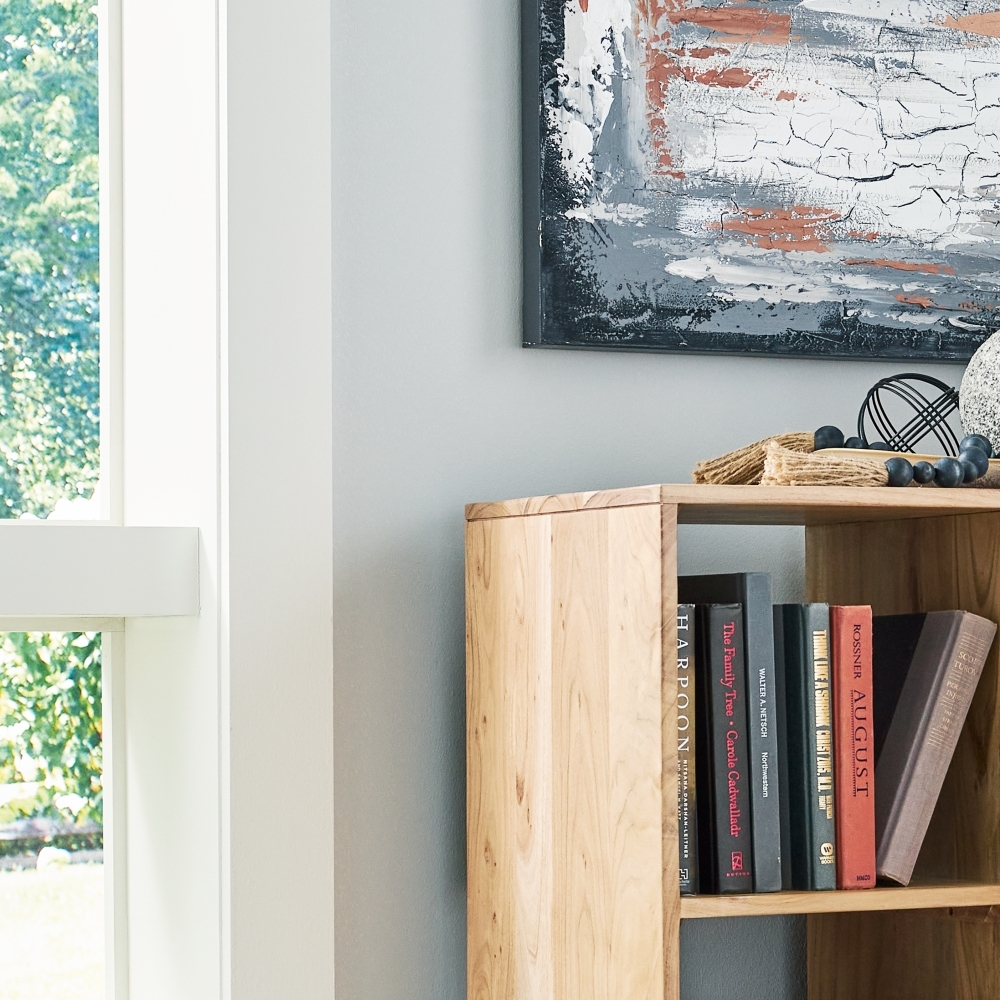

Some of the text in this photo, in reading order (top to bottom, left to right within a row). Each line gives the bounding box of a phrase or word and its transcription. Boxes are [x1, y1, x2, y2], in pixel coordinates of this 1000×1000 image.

[677, 614, 690, 752] HARPOON
[759, 668, 768, 738] WALTER A. NETSCH
[812, 630, 830, 728] THINK LIKE A SHRINK
[853, 624, 869, 797] ROSSNER AUGUST
[720, 622, 741, 837] The Family Tree Carole Cadwalladr
[761, 752, 769, 798] Northwestern
[818, 776, 832, 792] M.D.
